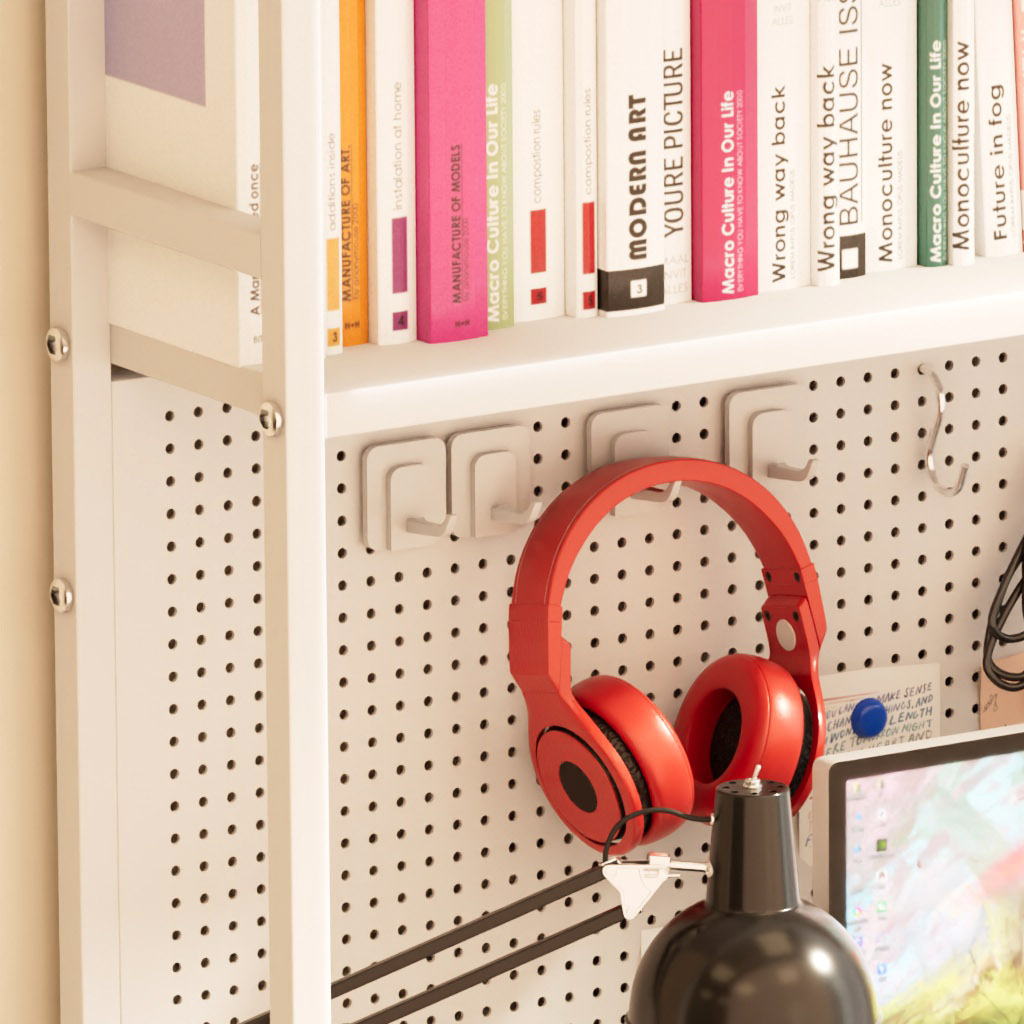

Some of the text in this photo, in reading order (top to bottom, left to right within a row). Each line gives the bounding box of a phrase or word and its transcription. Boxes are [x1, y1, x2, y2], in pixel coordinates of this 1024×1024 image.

[327, 132, 337, 171] inside
[392, 81, 403, 211] instalation at home
[532, 109, 542, 135] rules
[583, 88, 592, 117] rules
[663, 47, 684, 150] PICTURE
[838, 0, 859, 226] BAUHAUSE IS
[928, 39, 942, 264] Macro Culture In Our Life
[951, 41, 970, 251] Monoculture now
[250, 164, 259, 199] once
[341, 178, 351, 199] OF
[486, 83, 499, 323] Macro Culture In Our Life
[628, 94, 648, 260] MODERN ART
[663, 155, 685, 239] YOURE
[720, 90, 735, 294] Macro Culture In Our Life
[771, 85, 789, 283] Wrong way back
[816, 65, 838, 272] Wrong way back
[878, 63, 893, 263] Monoculture now
[988, 84, 1007, 241] Future in fog
[340, 204, 352, 302] MANUFACTURE
[450, 143, 462, 304] MANUFACTURE OF MODELS
[250, 306, 260, 315] A
[889, 706, 933, 726] LENGTH
[903, 682, 932, 698] SENSE
[915, 694, 934, 708] AND
